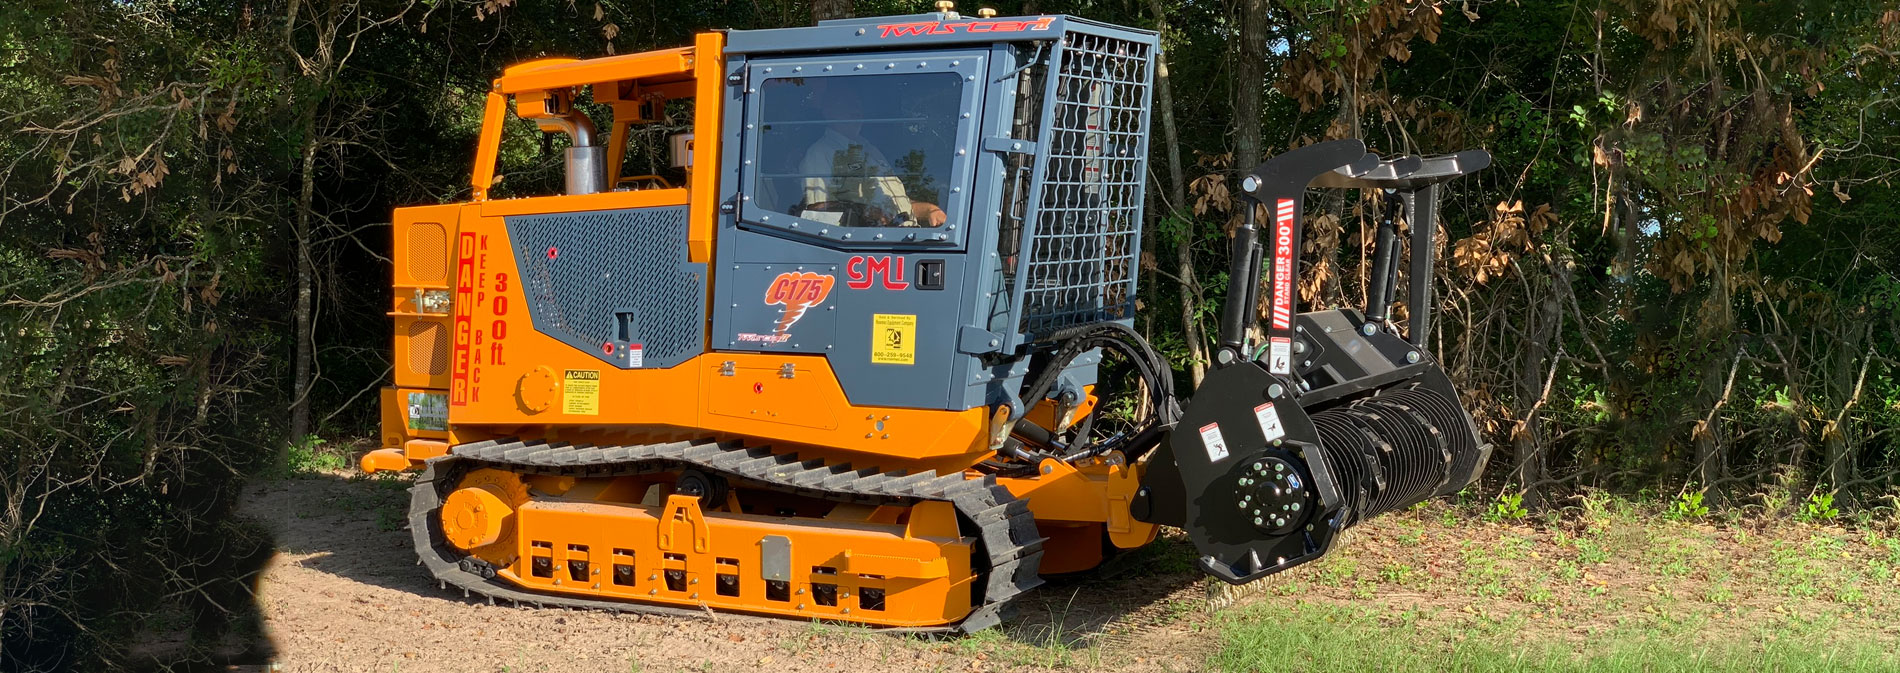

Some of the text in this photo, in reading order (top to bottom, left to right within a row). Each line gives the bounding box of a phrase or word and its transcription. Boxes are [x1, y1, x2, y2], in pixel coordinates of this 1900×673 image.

[774, 278, 825, 301] C175
[847, 256, 909, 290] CMI
[1275, 256, 1285, 306] DANGER
[453, 234, 474, 403] DANGER
[472, 234, 488, 403] KEEP BACK
[491, 272, 508, 341] 300
[573, 371, 599, 380] CAUTION
